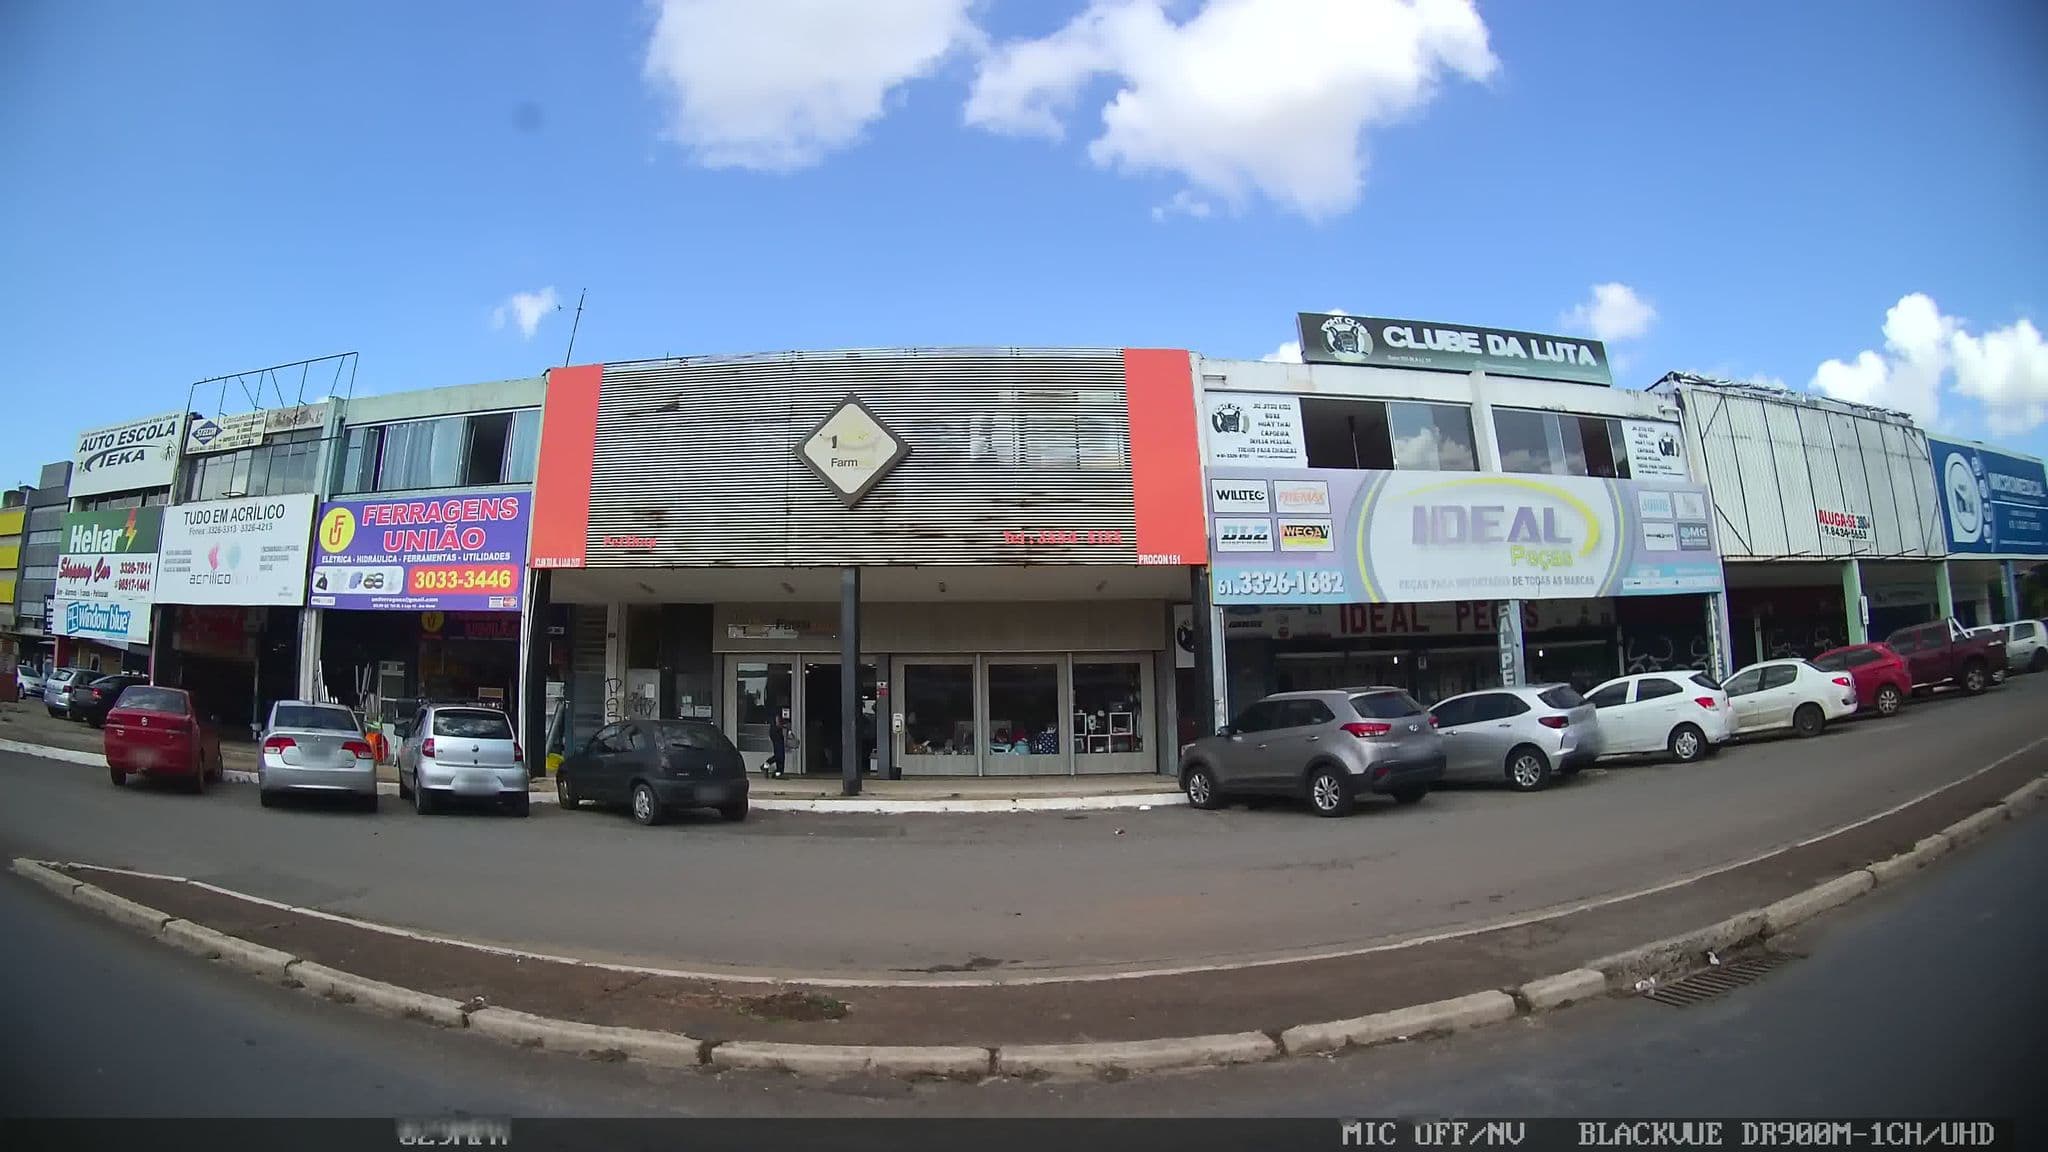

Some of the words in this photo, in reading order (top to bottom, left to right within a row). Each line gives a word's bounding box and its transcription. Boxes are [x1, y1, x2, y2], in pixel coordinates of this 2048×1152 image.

[1383, 326, 1482, 354] CLUBE
[1485, 334, 1528, 359] DA
[1530, 339, 1597, 367] LUTA
[79, 434, 115, 453] AUTO
[117, 421, 176, 446] ESCOLA
[98, 449, 145, 468] TEKA
[831, 458, 858, 468] Farm
[1216, 489, 1265, 501] WILLTEC
[184, 510, 211, 525] TUDO
[213, 508, 228, 523] EM
[231, 502, 285, 522] ACRÍLICO
[361, 498, 519, 527] FERRAGENS
[1819, 510, 1856, 529] ALUGA-SE
[1284, 525, 1321, 538] WEGA
[1412, 505, 1573, 544] IDEAL
[383, 524, 487, 553] UNIÃO
[403, 554, 457, 563] FERRAMENTAS
[463, 552, 510, 562] UTILIDADES
[1138, 554, 1168, 565] PROCON
[1169, 554, 1181, 565] 151
[414, 569, 511, 588] 3033-3446
[1218, 571, 1344, 595] 61.3326-1682
[1512, 576, 1523, 586] DE
[1552, 576, 1563, 585] AS
[1565, 575, 1595, 585] MARCAS
[79, 604, 109, 630] Window
[109, 604, 129, 632] blue
[1340, 602, 1430, 634] IDEAL
